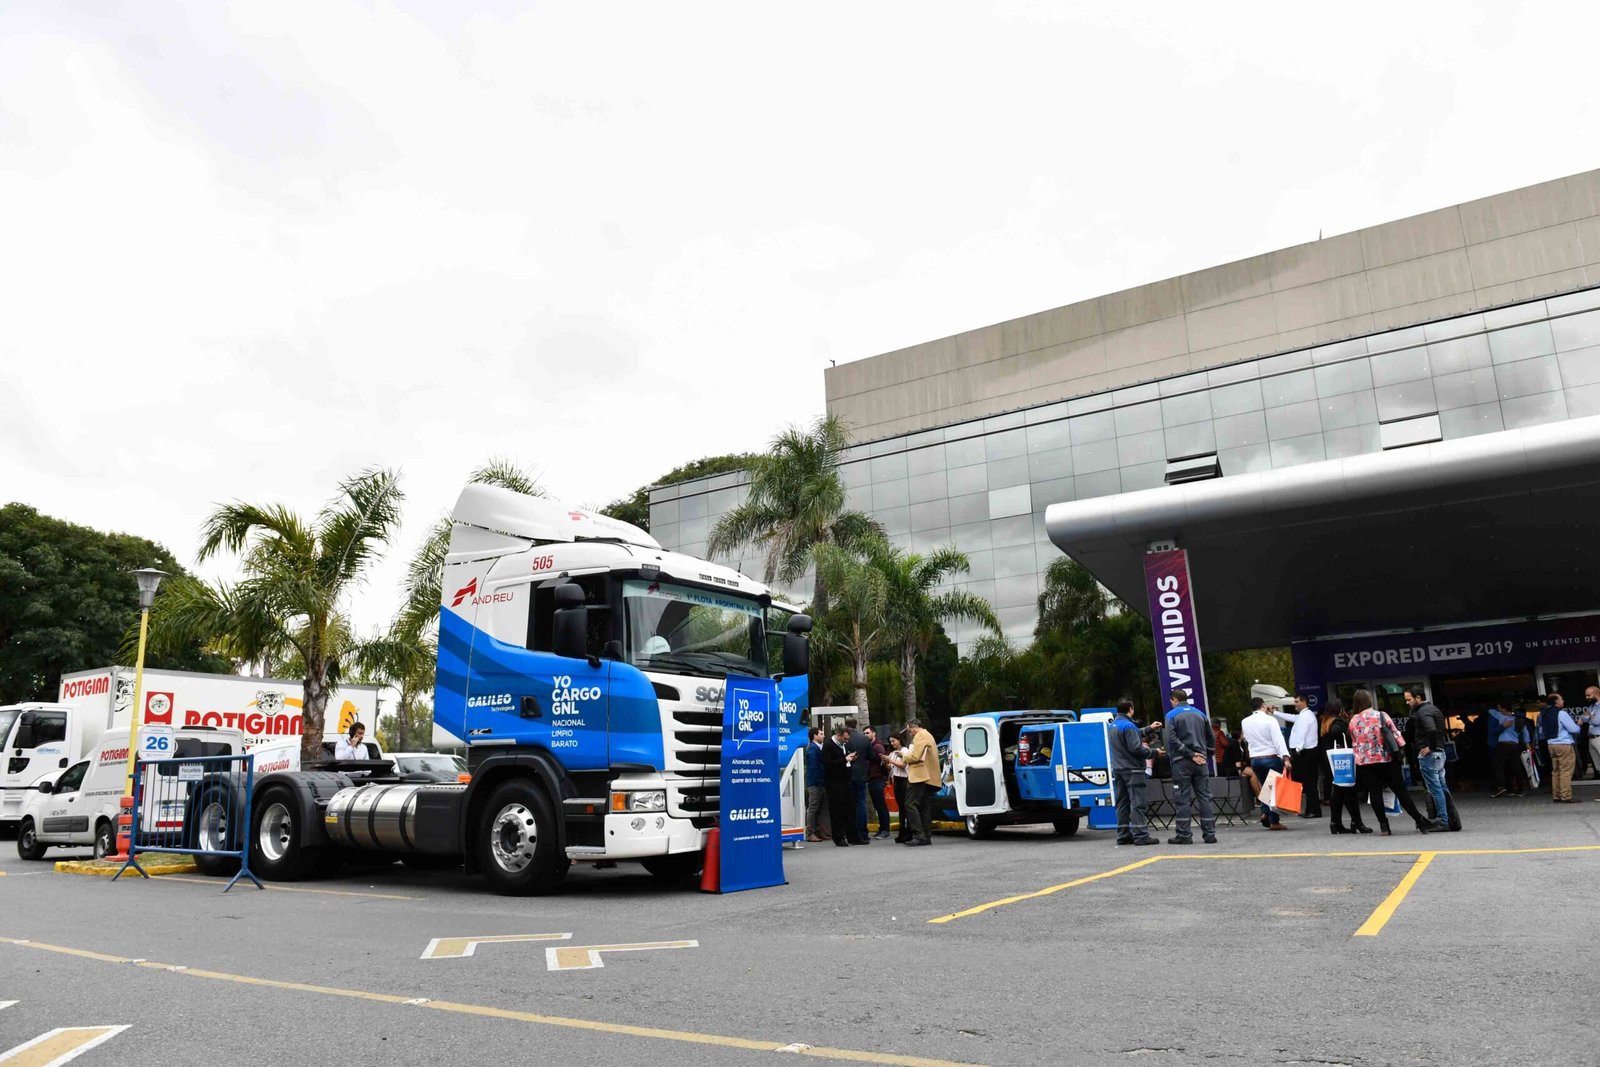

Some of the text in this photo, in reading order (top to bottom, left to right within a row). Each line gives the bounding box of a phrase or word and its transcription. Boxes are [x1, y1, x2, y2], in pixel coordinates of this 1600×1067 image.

[532, 555, 554, 570] 505
[694, 595, 713, 605] FLOTA
[715, 600, 744, 610] ARGENTINA
[1333, 647, 1426, 668] EXPORED
[1433, 646, 1467, 657] YPF
[1475, 640, 1513, 656] 2019
[1543, 637, 1580, 646] EVENTO
[552, 675, 571, 689] YO
[467, 693, 512, 708] GALILEO
[551, 687, 601, 703] CARGO
[551, 701, 579, 715] GNL
[738, 699, 749, 710] YO
[552, 719, 586, 727] NACIONAL
[738, 710, 764, 722] CARGO
[738, 721, 753, 732] GNL
[146, 736, 168, 750] 26
[551, 740, 578, 748] BARATO
[729, 807, 769, 821] GALILEO
